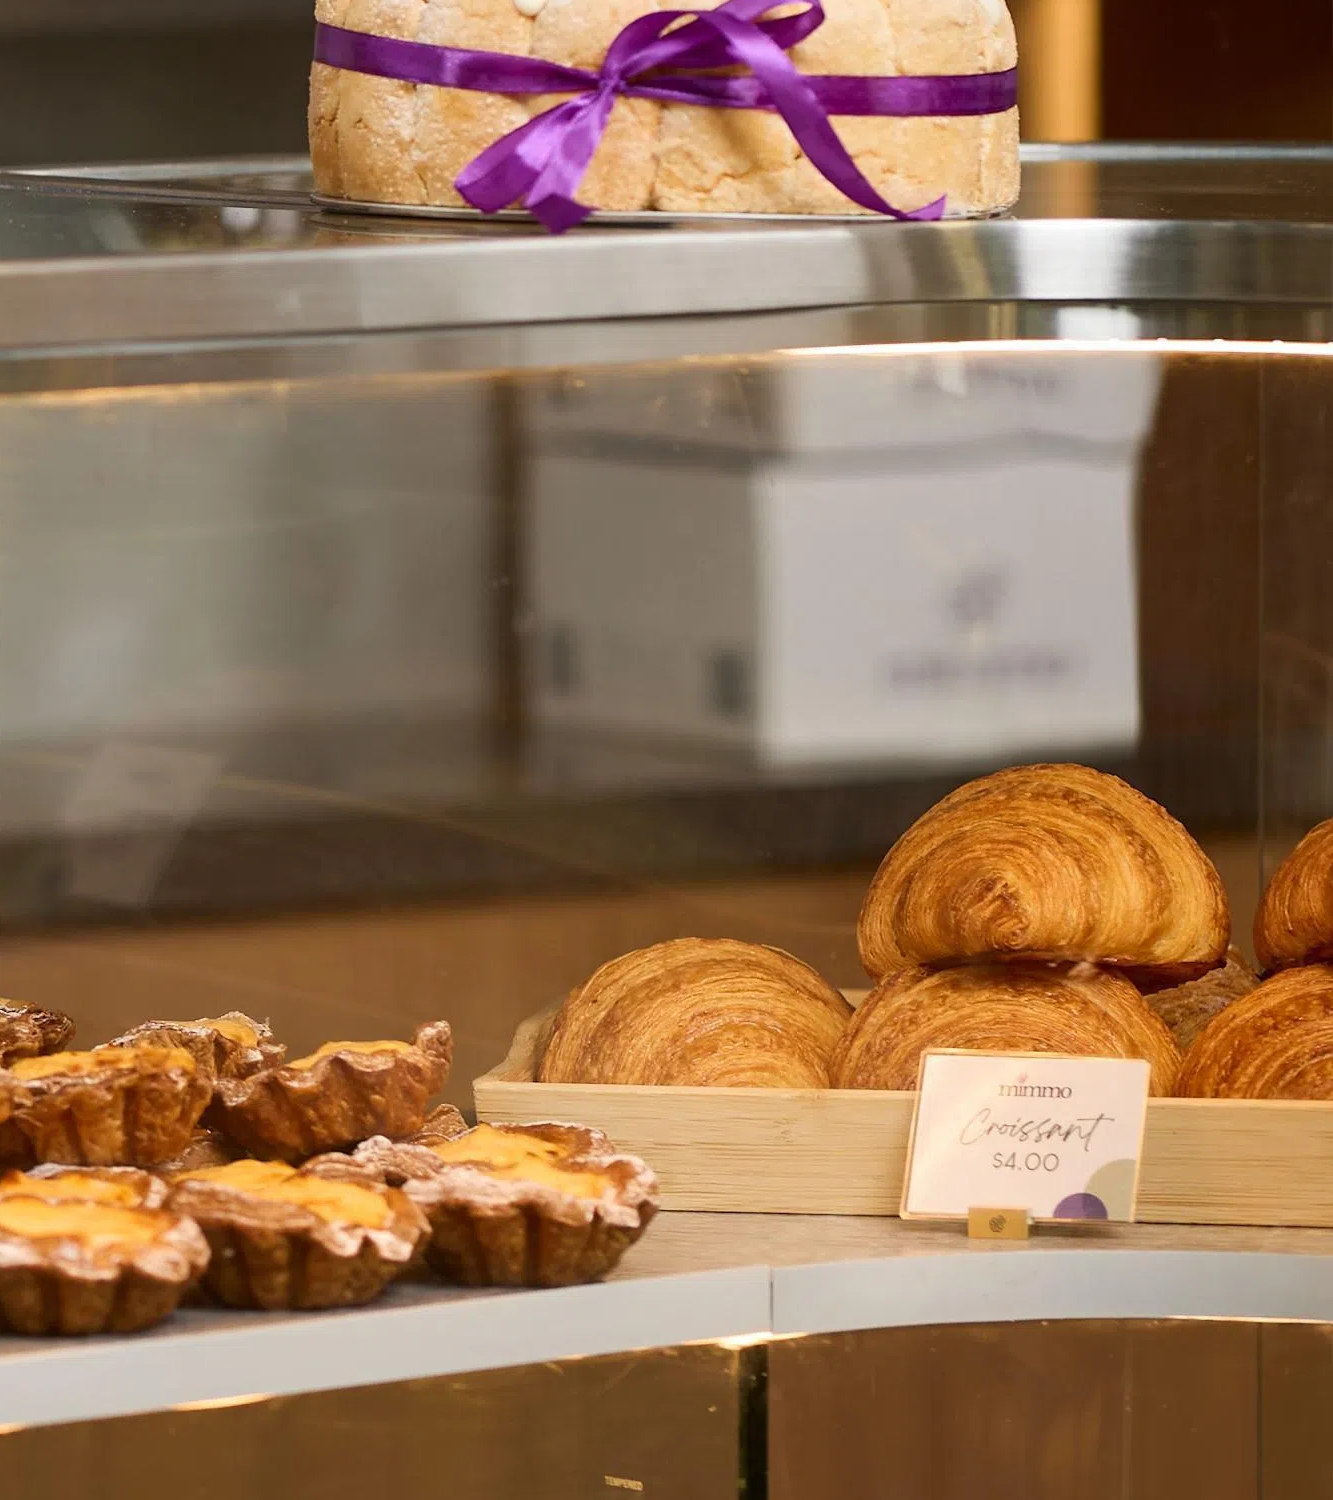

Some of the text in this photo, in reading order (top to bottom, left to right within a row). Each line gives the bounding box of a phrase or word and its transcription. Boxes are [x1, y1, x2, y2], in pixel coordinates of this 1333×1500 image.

[998, 1079, 1073, 1099] mimmo
[959, 1108, 1116, 1152] Croissant
[991, 1151, 1061, 1172] $4.00
